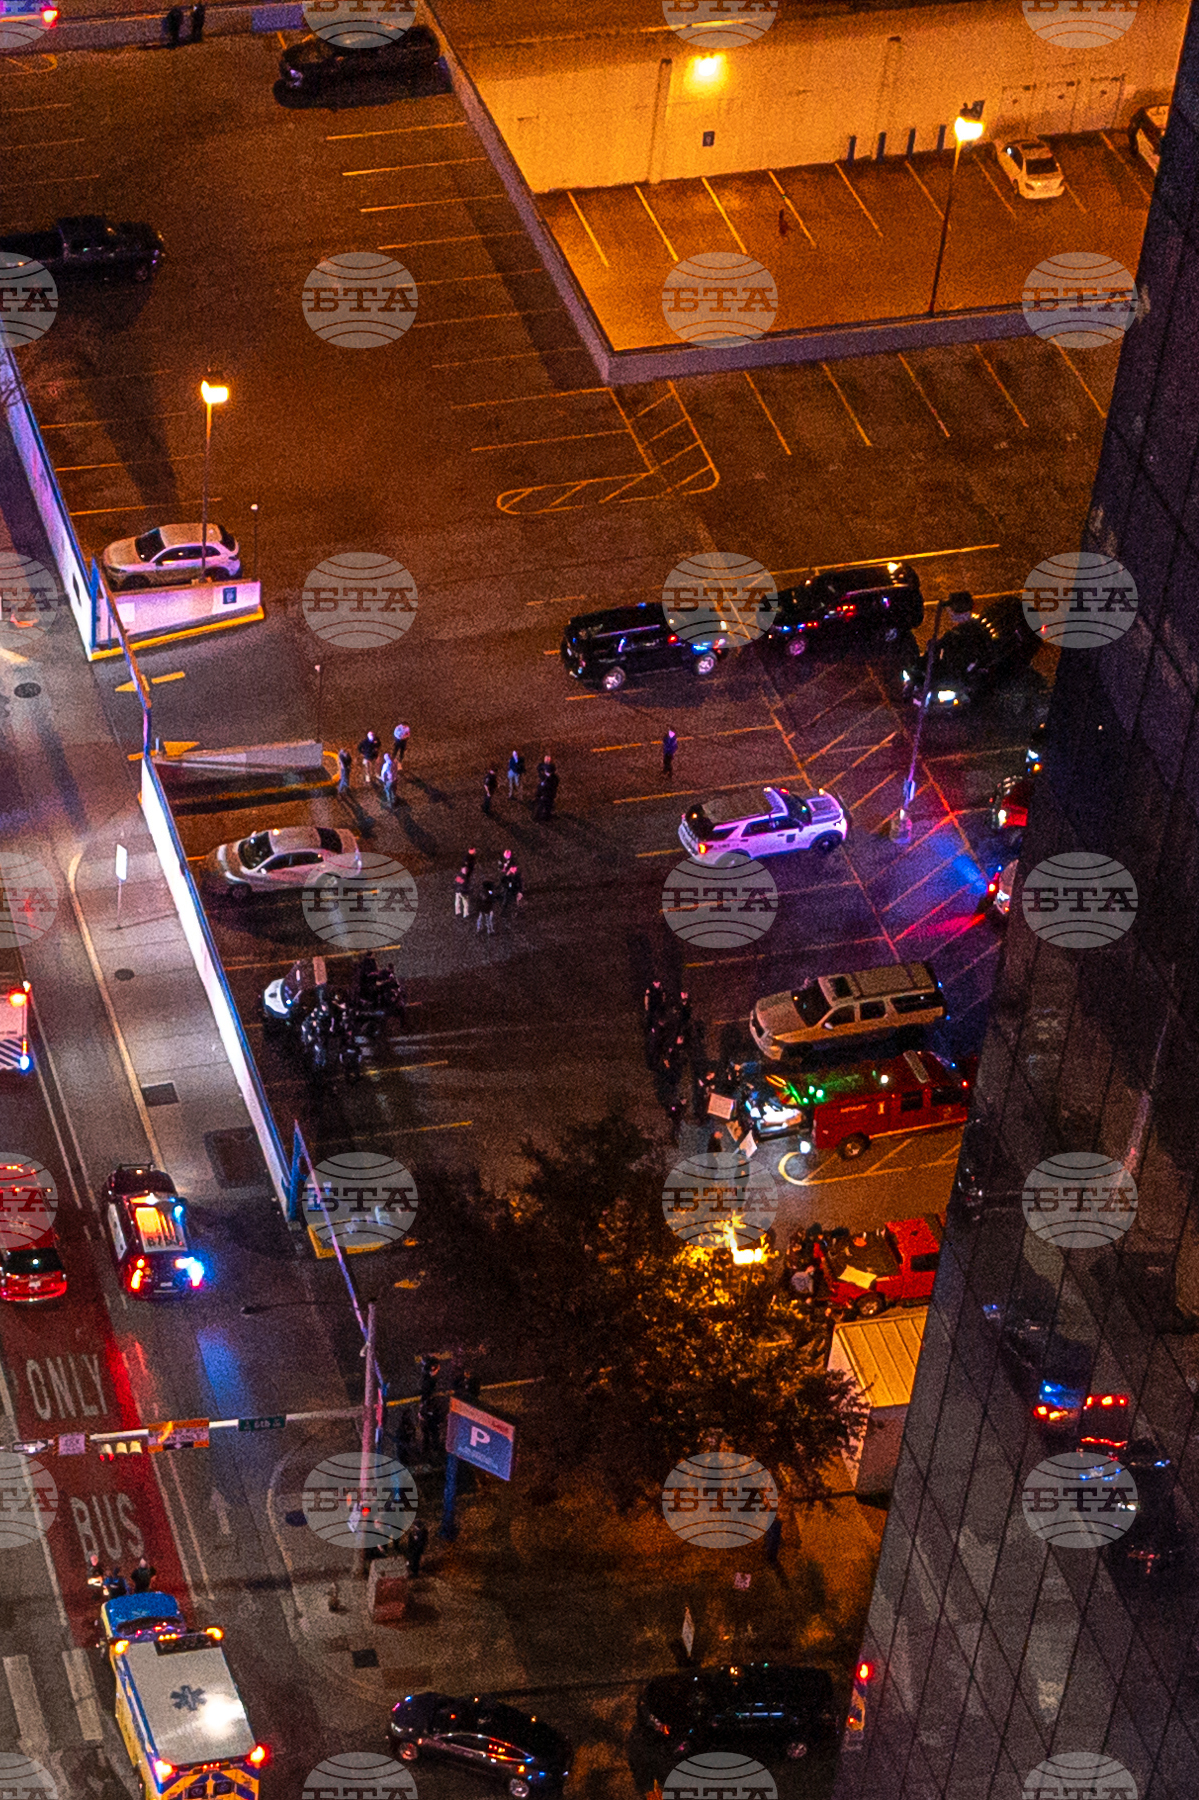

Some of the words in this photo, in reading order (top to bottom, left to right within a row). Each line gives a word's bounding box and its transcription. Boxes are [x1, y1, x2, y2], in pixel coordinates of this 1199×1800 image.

[26, 1353, 108, 1420] ONLY
[470, 1426, 491, 1447] P
[70, 1492, 145, 1564] BUS
